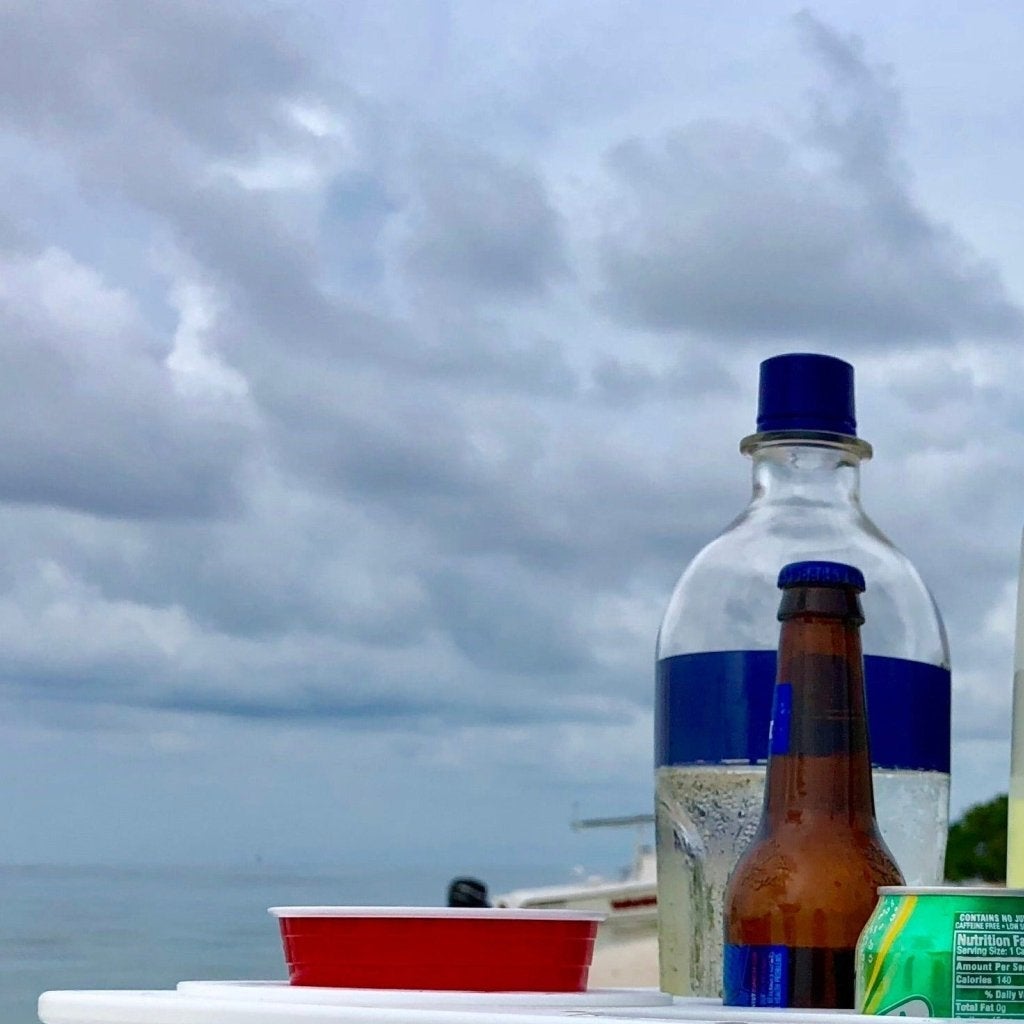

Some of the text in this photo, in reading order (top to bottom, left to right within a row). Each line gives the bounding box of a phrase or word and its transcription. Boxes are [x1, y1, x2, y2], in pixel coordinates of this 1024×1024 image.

[960, 914, 999, 922] CONTAINS
[1001, 914, 1012, 922] NO
[955, 922, 984, 930] CAFFEINE
[985, 922, 1000, 930] FREE
[957, 933, 1010, 947] Nutrition
[957, 946, 987, 956] Serving
[989, 947, 1007, 955] Size:
[1010, 947, 1013, 955] 1
[956, 962, 992, 971] Amount
[995, 963, 1010, 971] Per
[956, 975, 1012, 984] Calories 140
[984, 990, 993, 999] %
[995, 990, 1016, 1000] Daily
[955, 1003, 978, 1012] Total
[980, 1003, 994, 1012] Fat
[996, 1004, 1006, 1013] 0g
